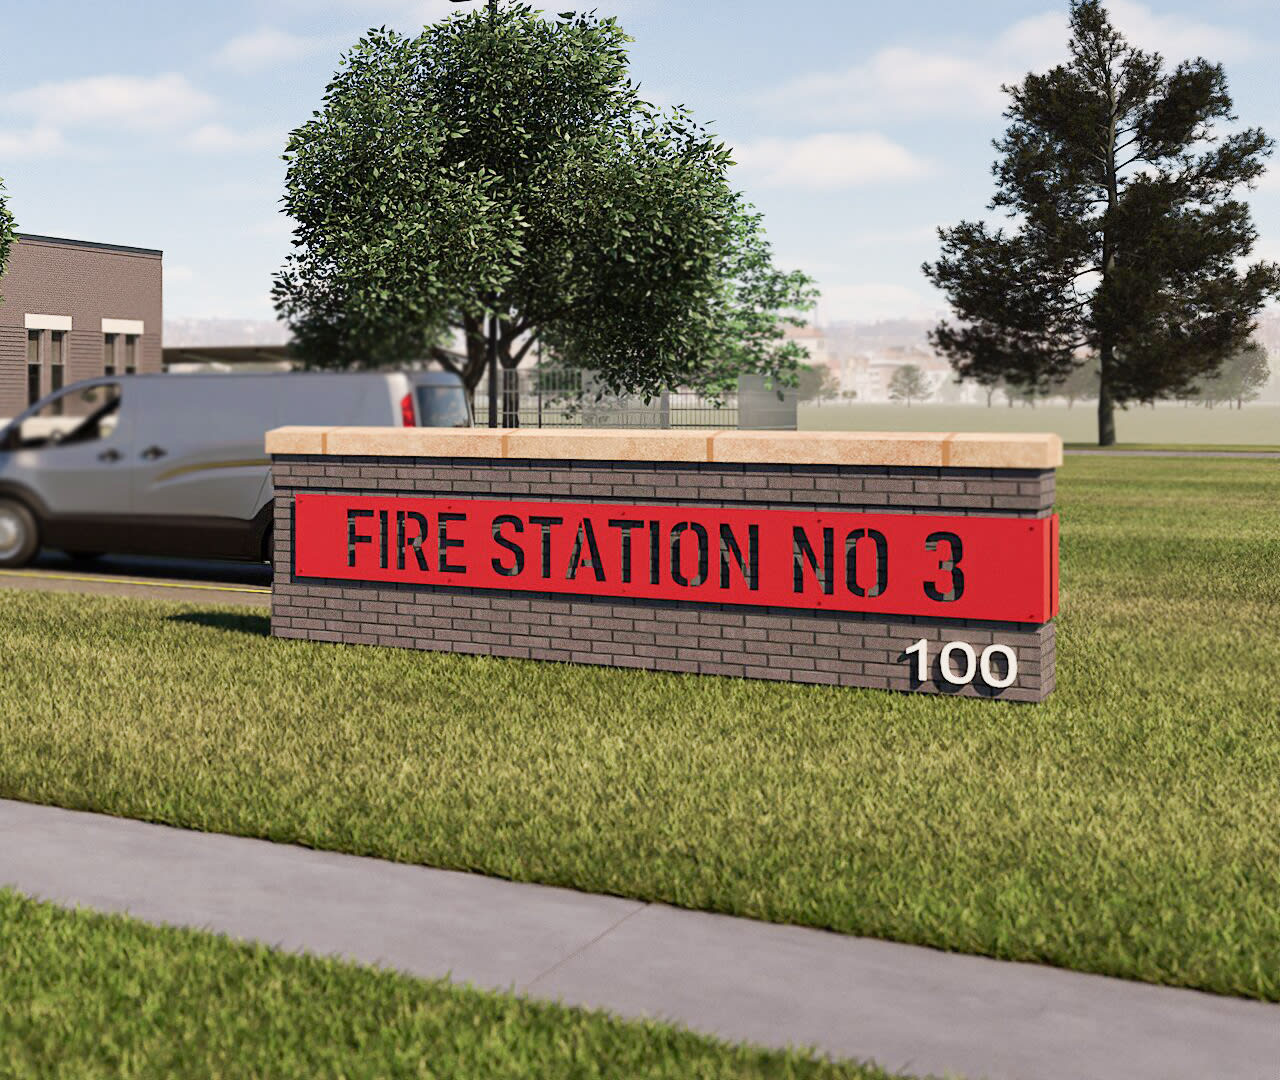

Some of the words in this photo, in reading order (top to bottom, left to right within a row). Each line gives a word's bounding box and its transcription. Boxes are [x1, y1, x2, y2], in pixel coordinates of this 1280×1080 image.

[347, 508, 467, 574] FIRE
[491, 514, 759, 591] STATION
[793, 525, 888, 597] NO
[923, 531, 965, 602] 3
[905, 638, 1018, 688] 100
